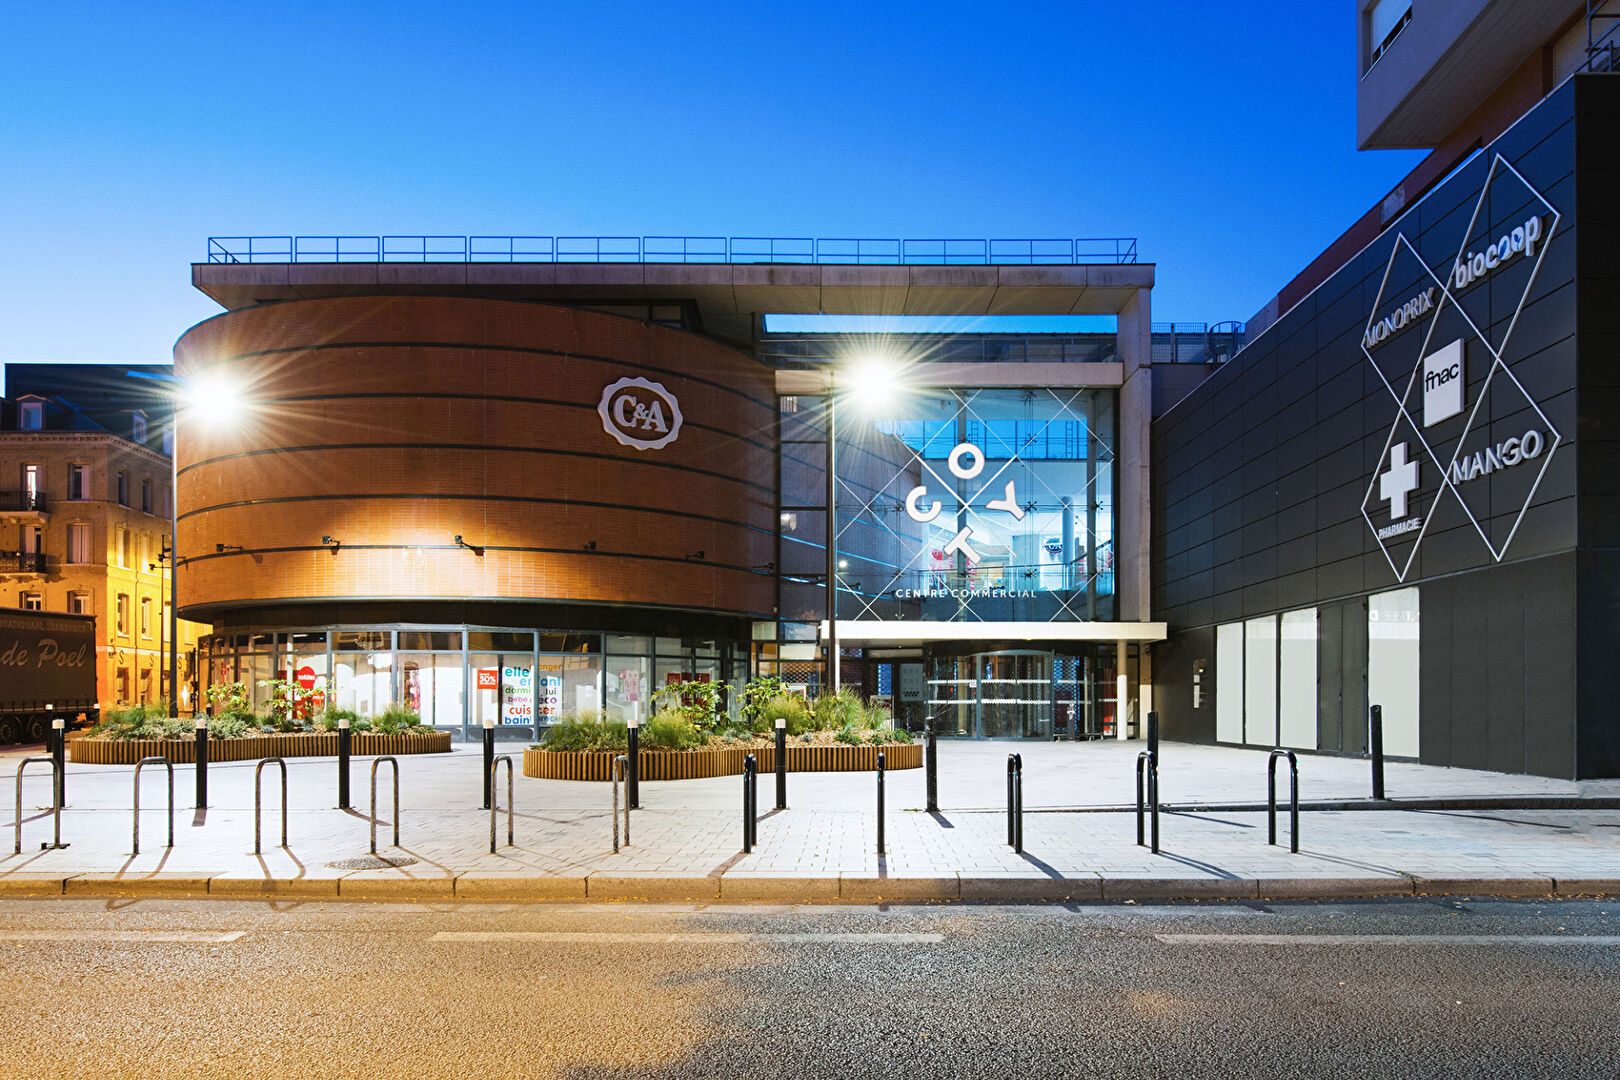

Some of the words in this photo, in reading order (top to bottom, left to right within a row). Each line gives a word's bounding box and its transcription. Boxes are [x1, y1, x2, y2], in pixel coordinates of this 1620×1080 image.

[1456, 216, 1542, 289] biocoop
[1366, 286, 1436, 349] MONOPRIX
[1425, 363, 1459, 392] fnac
[614, 395, 668, 432] C&A
[1453, 430, 1544, 485] MANGO
[1378, 517, 1422, 540] PHARMACIE
[896, 589, 946, 598] CENTRE
[951, 589, 1037, 598] COMMERCIAL
[1, 640, 29, 666] de
[38, 638, 87, 668] Poel
[505, 666, 530, 677] elle
